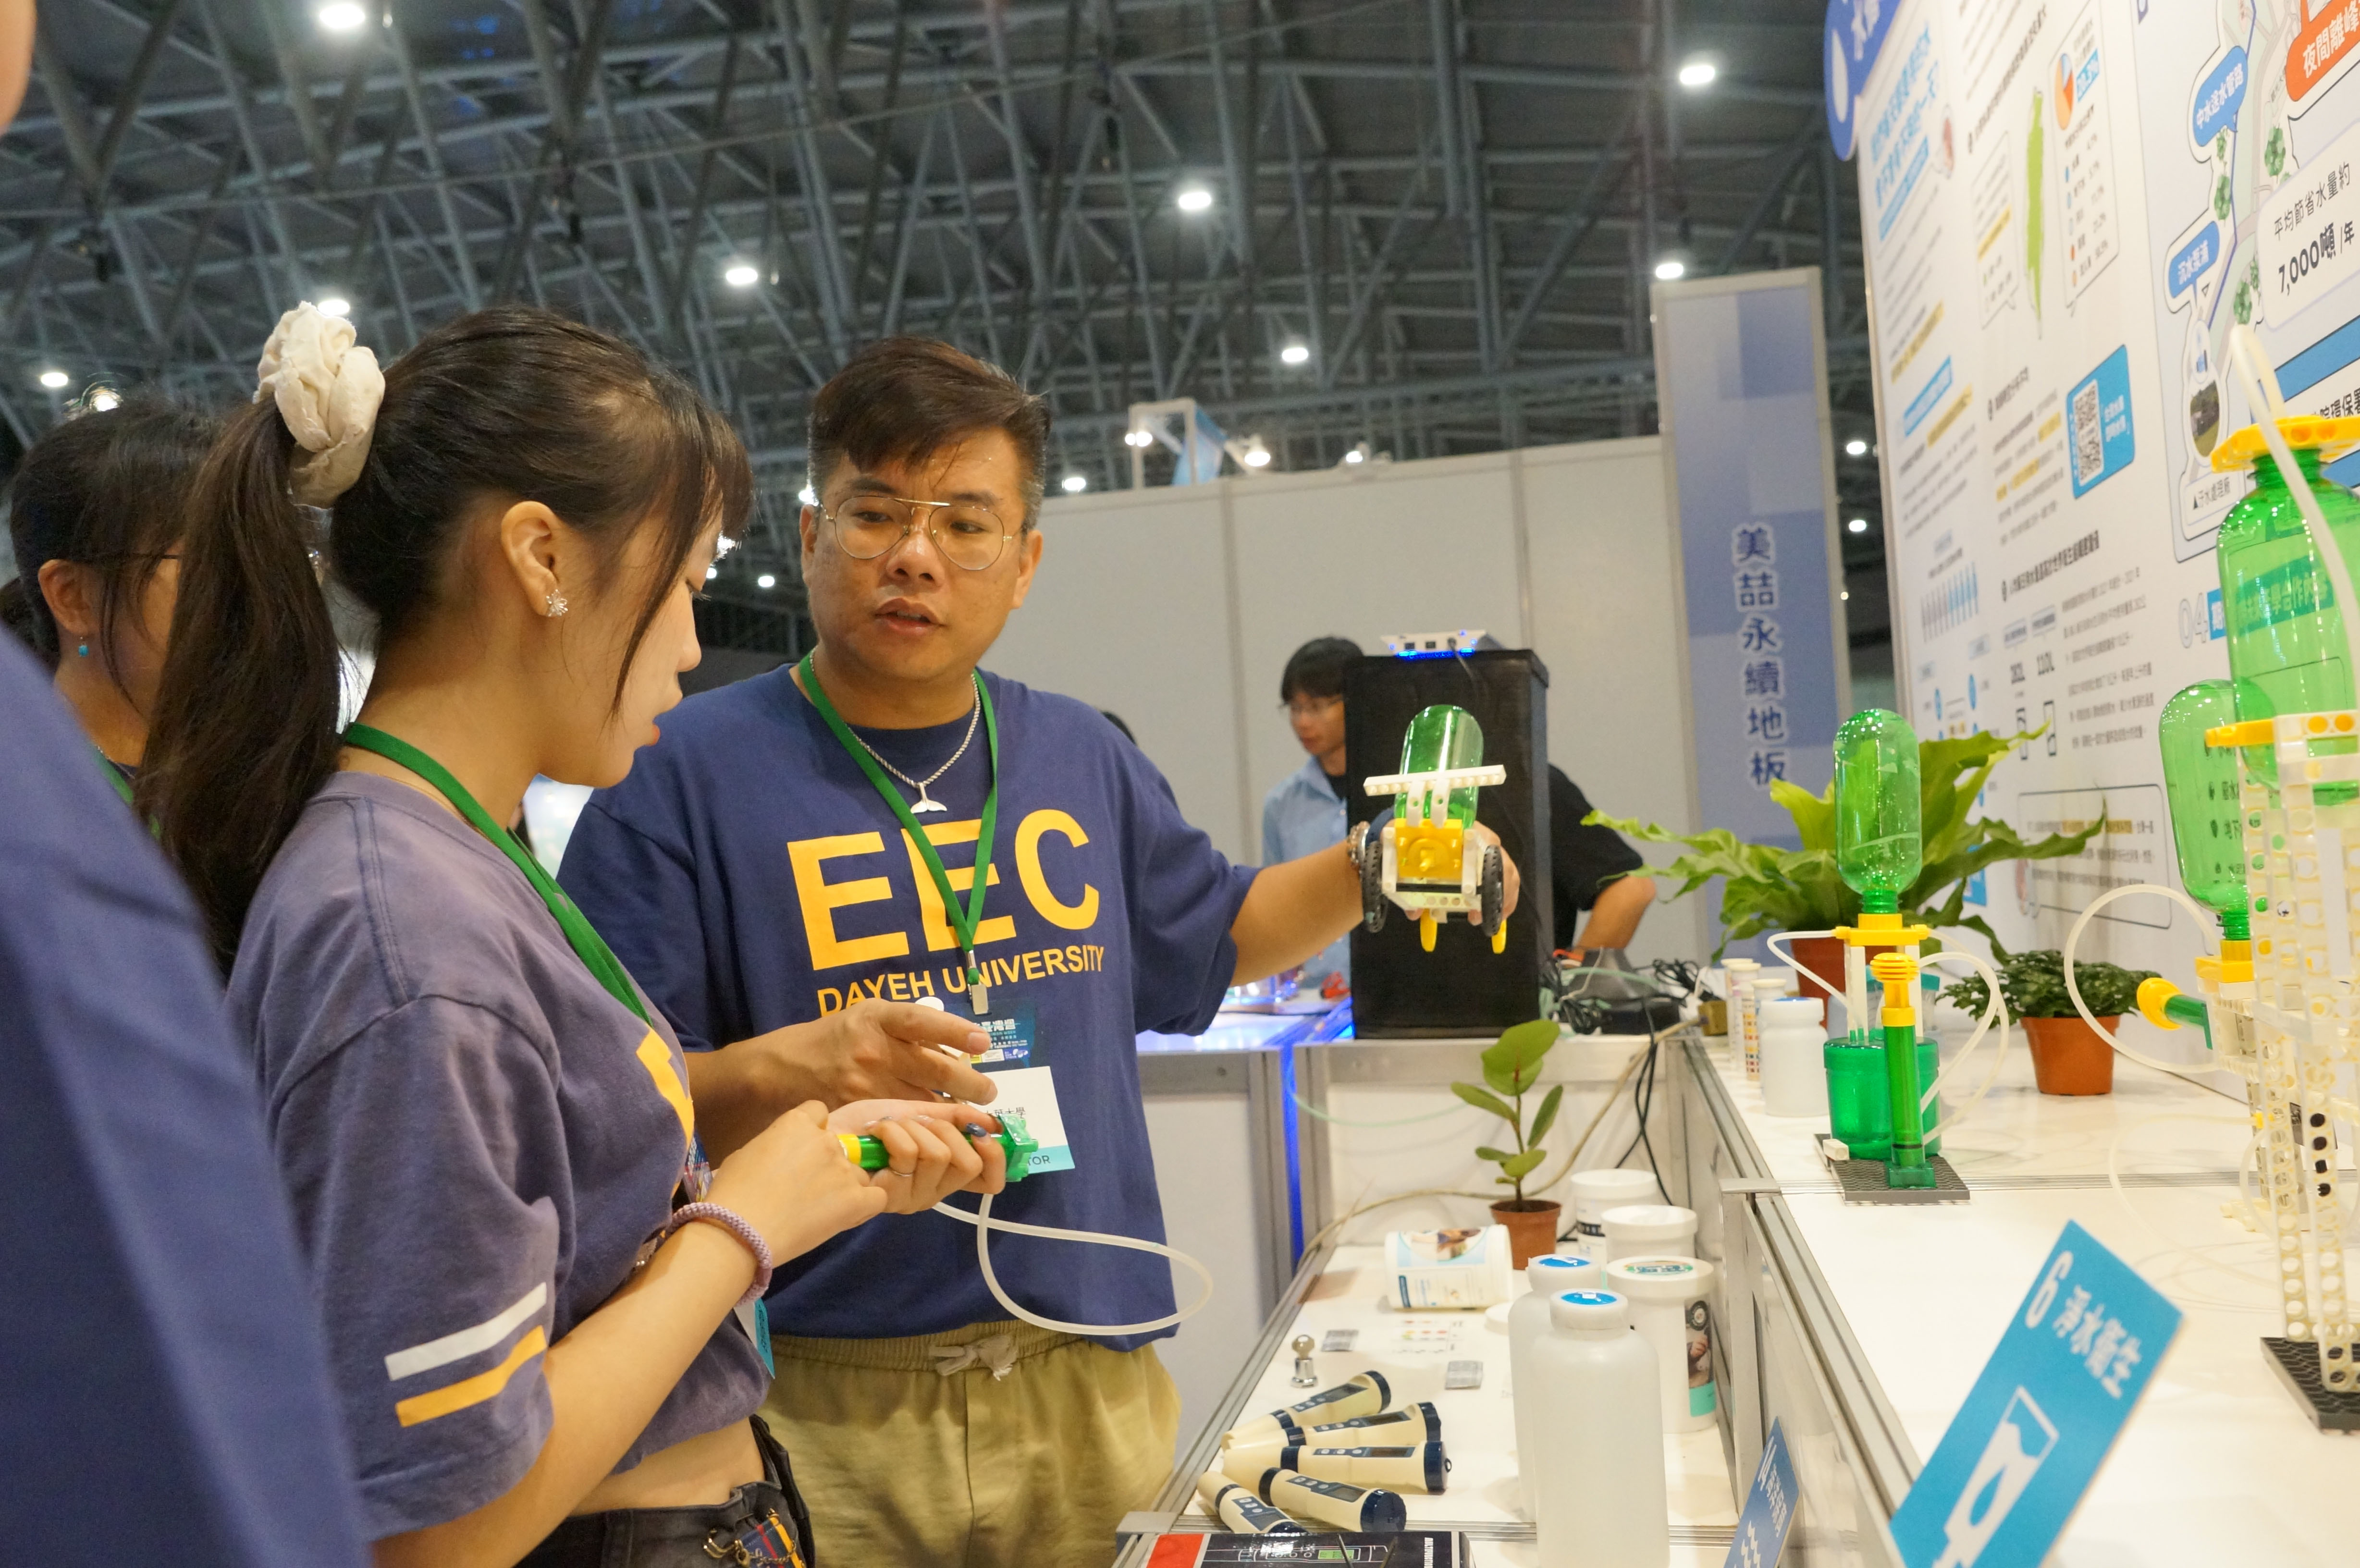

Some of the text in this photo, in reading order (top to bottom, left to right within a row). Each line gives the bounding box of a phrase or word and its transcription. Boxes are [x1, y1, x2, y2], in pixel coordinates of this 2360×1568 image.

[2303, 0, 2360, 79] 夜間離峰
[2274, 162, 2350, 241] 平均節省水量約
[2278, 222, 2336, 296] 7,000噸
[2312, 387, 2360, 419] 院環保署
[1736, 527, 1786, 785] 美喆永續地板
[787, 809, 1100, 970] EEC
[817, 944, 1104, 1017] DAYEH UNIVERSITY
[2025, 1250, 2074, 1329] 6
[1758, 1435, 1777, 1491] 14
